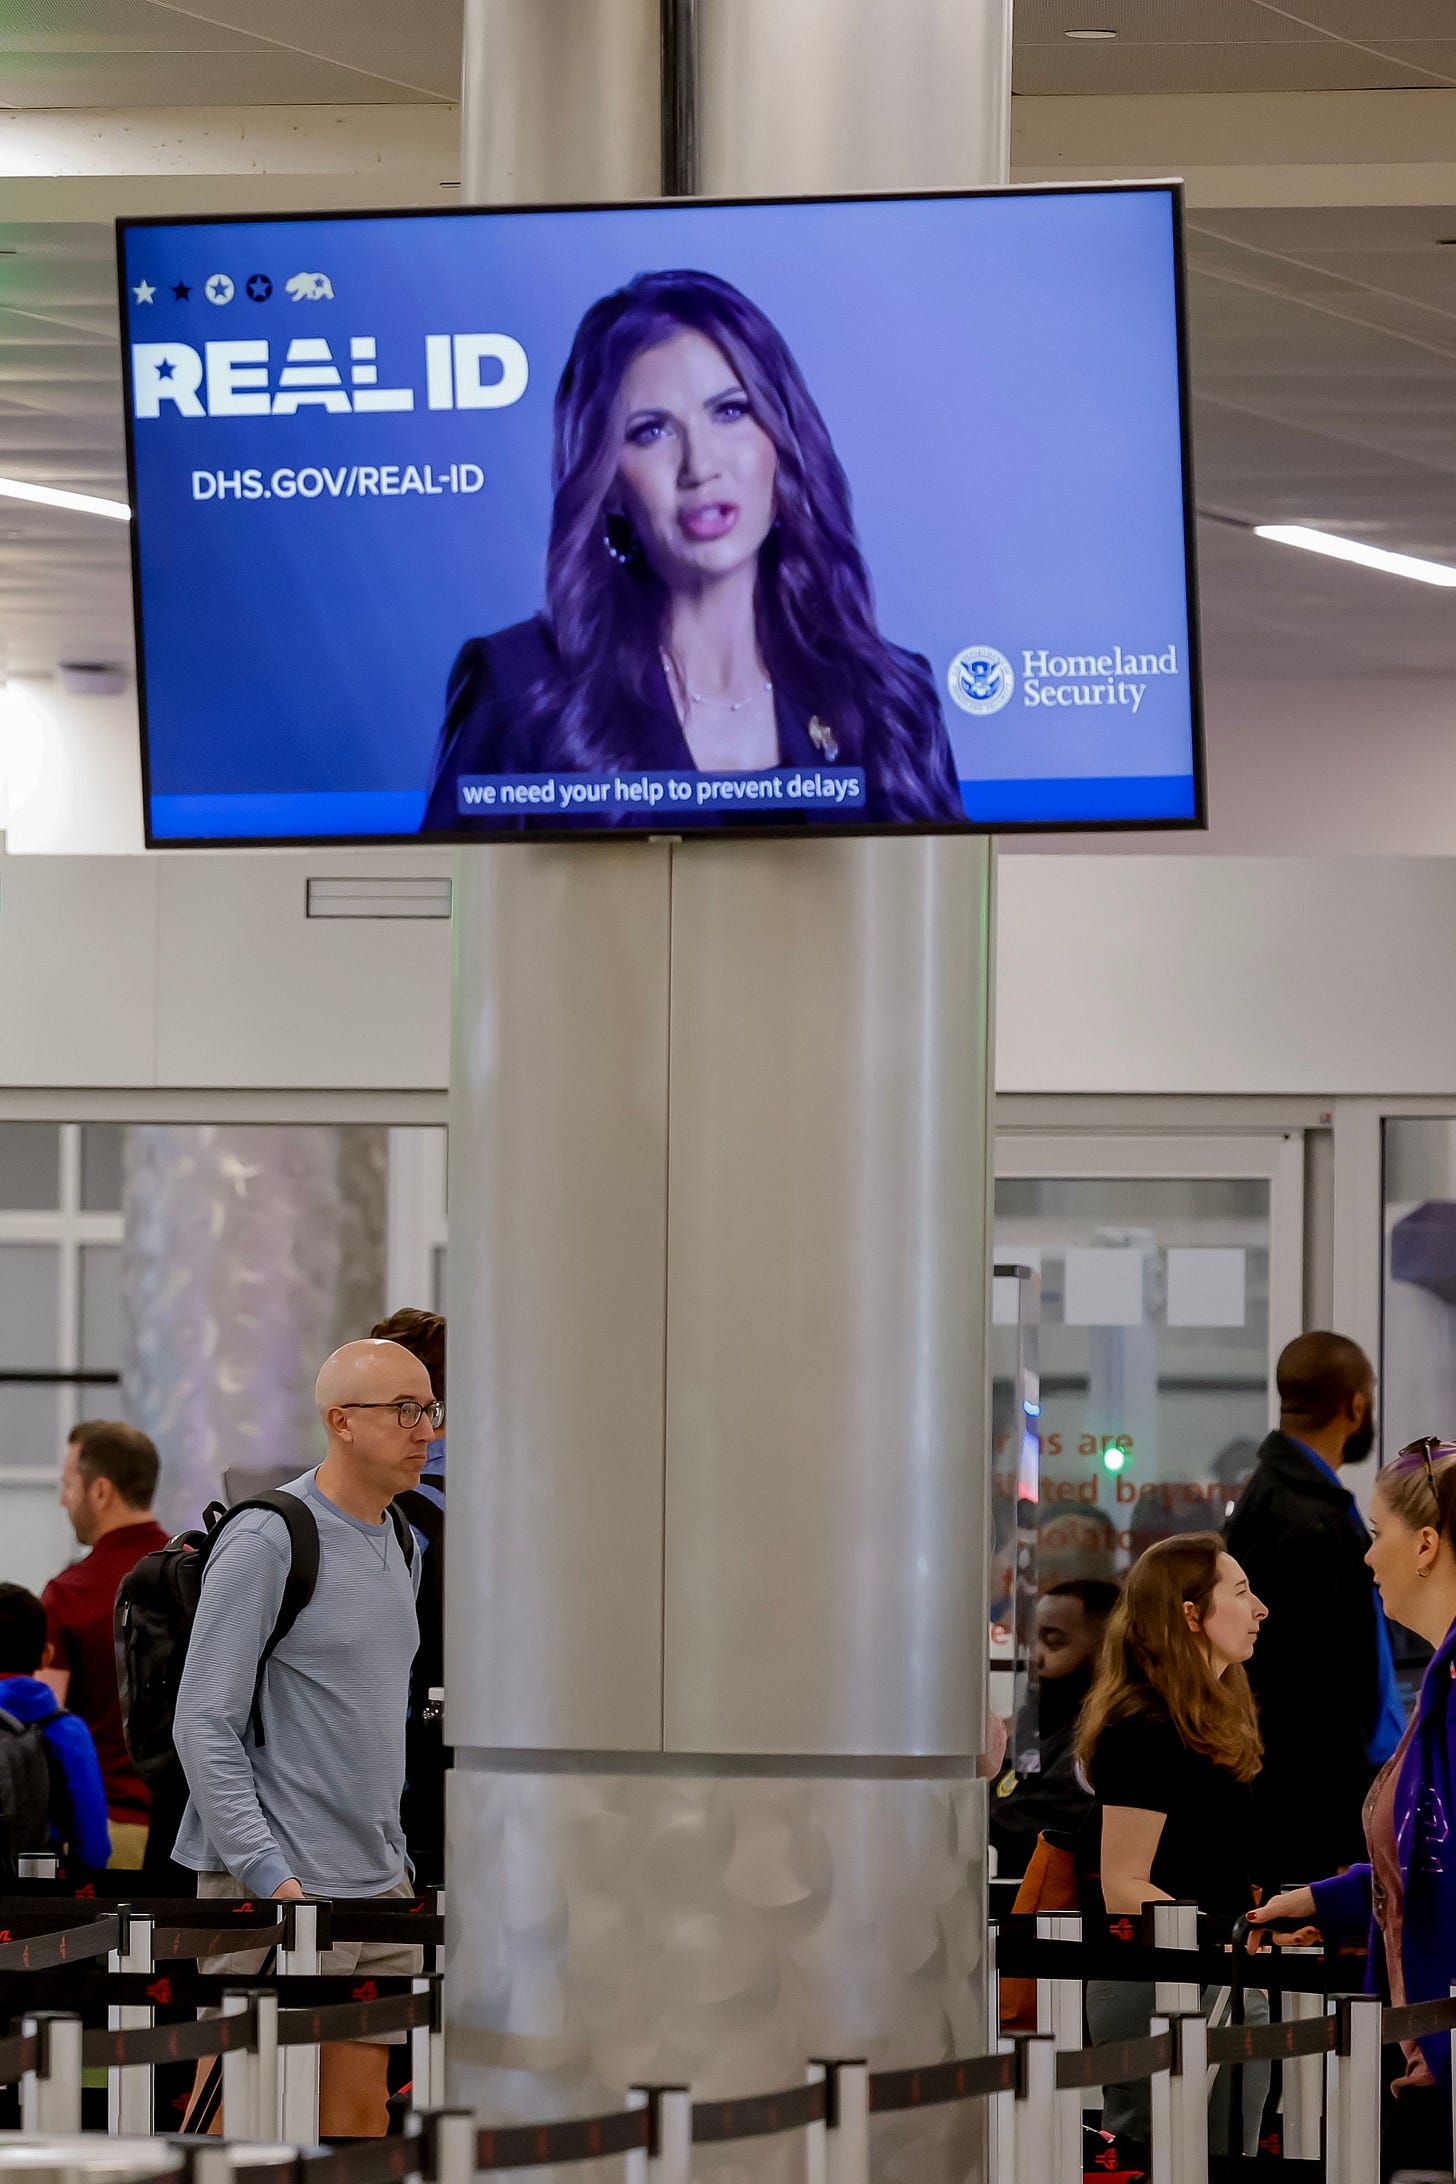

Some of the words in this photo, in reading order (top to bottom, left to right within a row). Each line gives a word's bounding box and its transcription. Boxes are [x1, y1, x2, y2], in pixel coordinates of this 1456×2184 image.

[132, 336, 414, 419] REAL
[424, 333, 530, 412] ID
[192, 463, 486, 501] DHS.GOV/REAL-ID
[1022, 644, 1179, 678] Homeland
[1023, 677, 1148, 714] Security
[462, 786, 496, 805] we
[500, 778, 555, 804] need
[559, 783, 610, 808] your
[614, 776, 661, 806] help
[668, 779, 692, 801] to
[697, 776, 783, 806] prevent
[786, 773, 861, 803] delays
